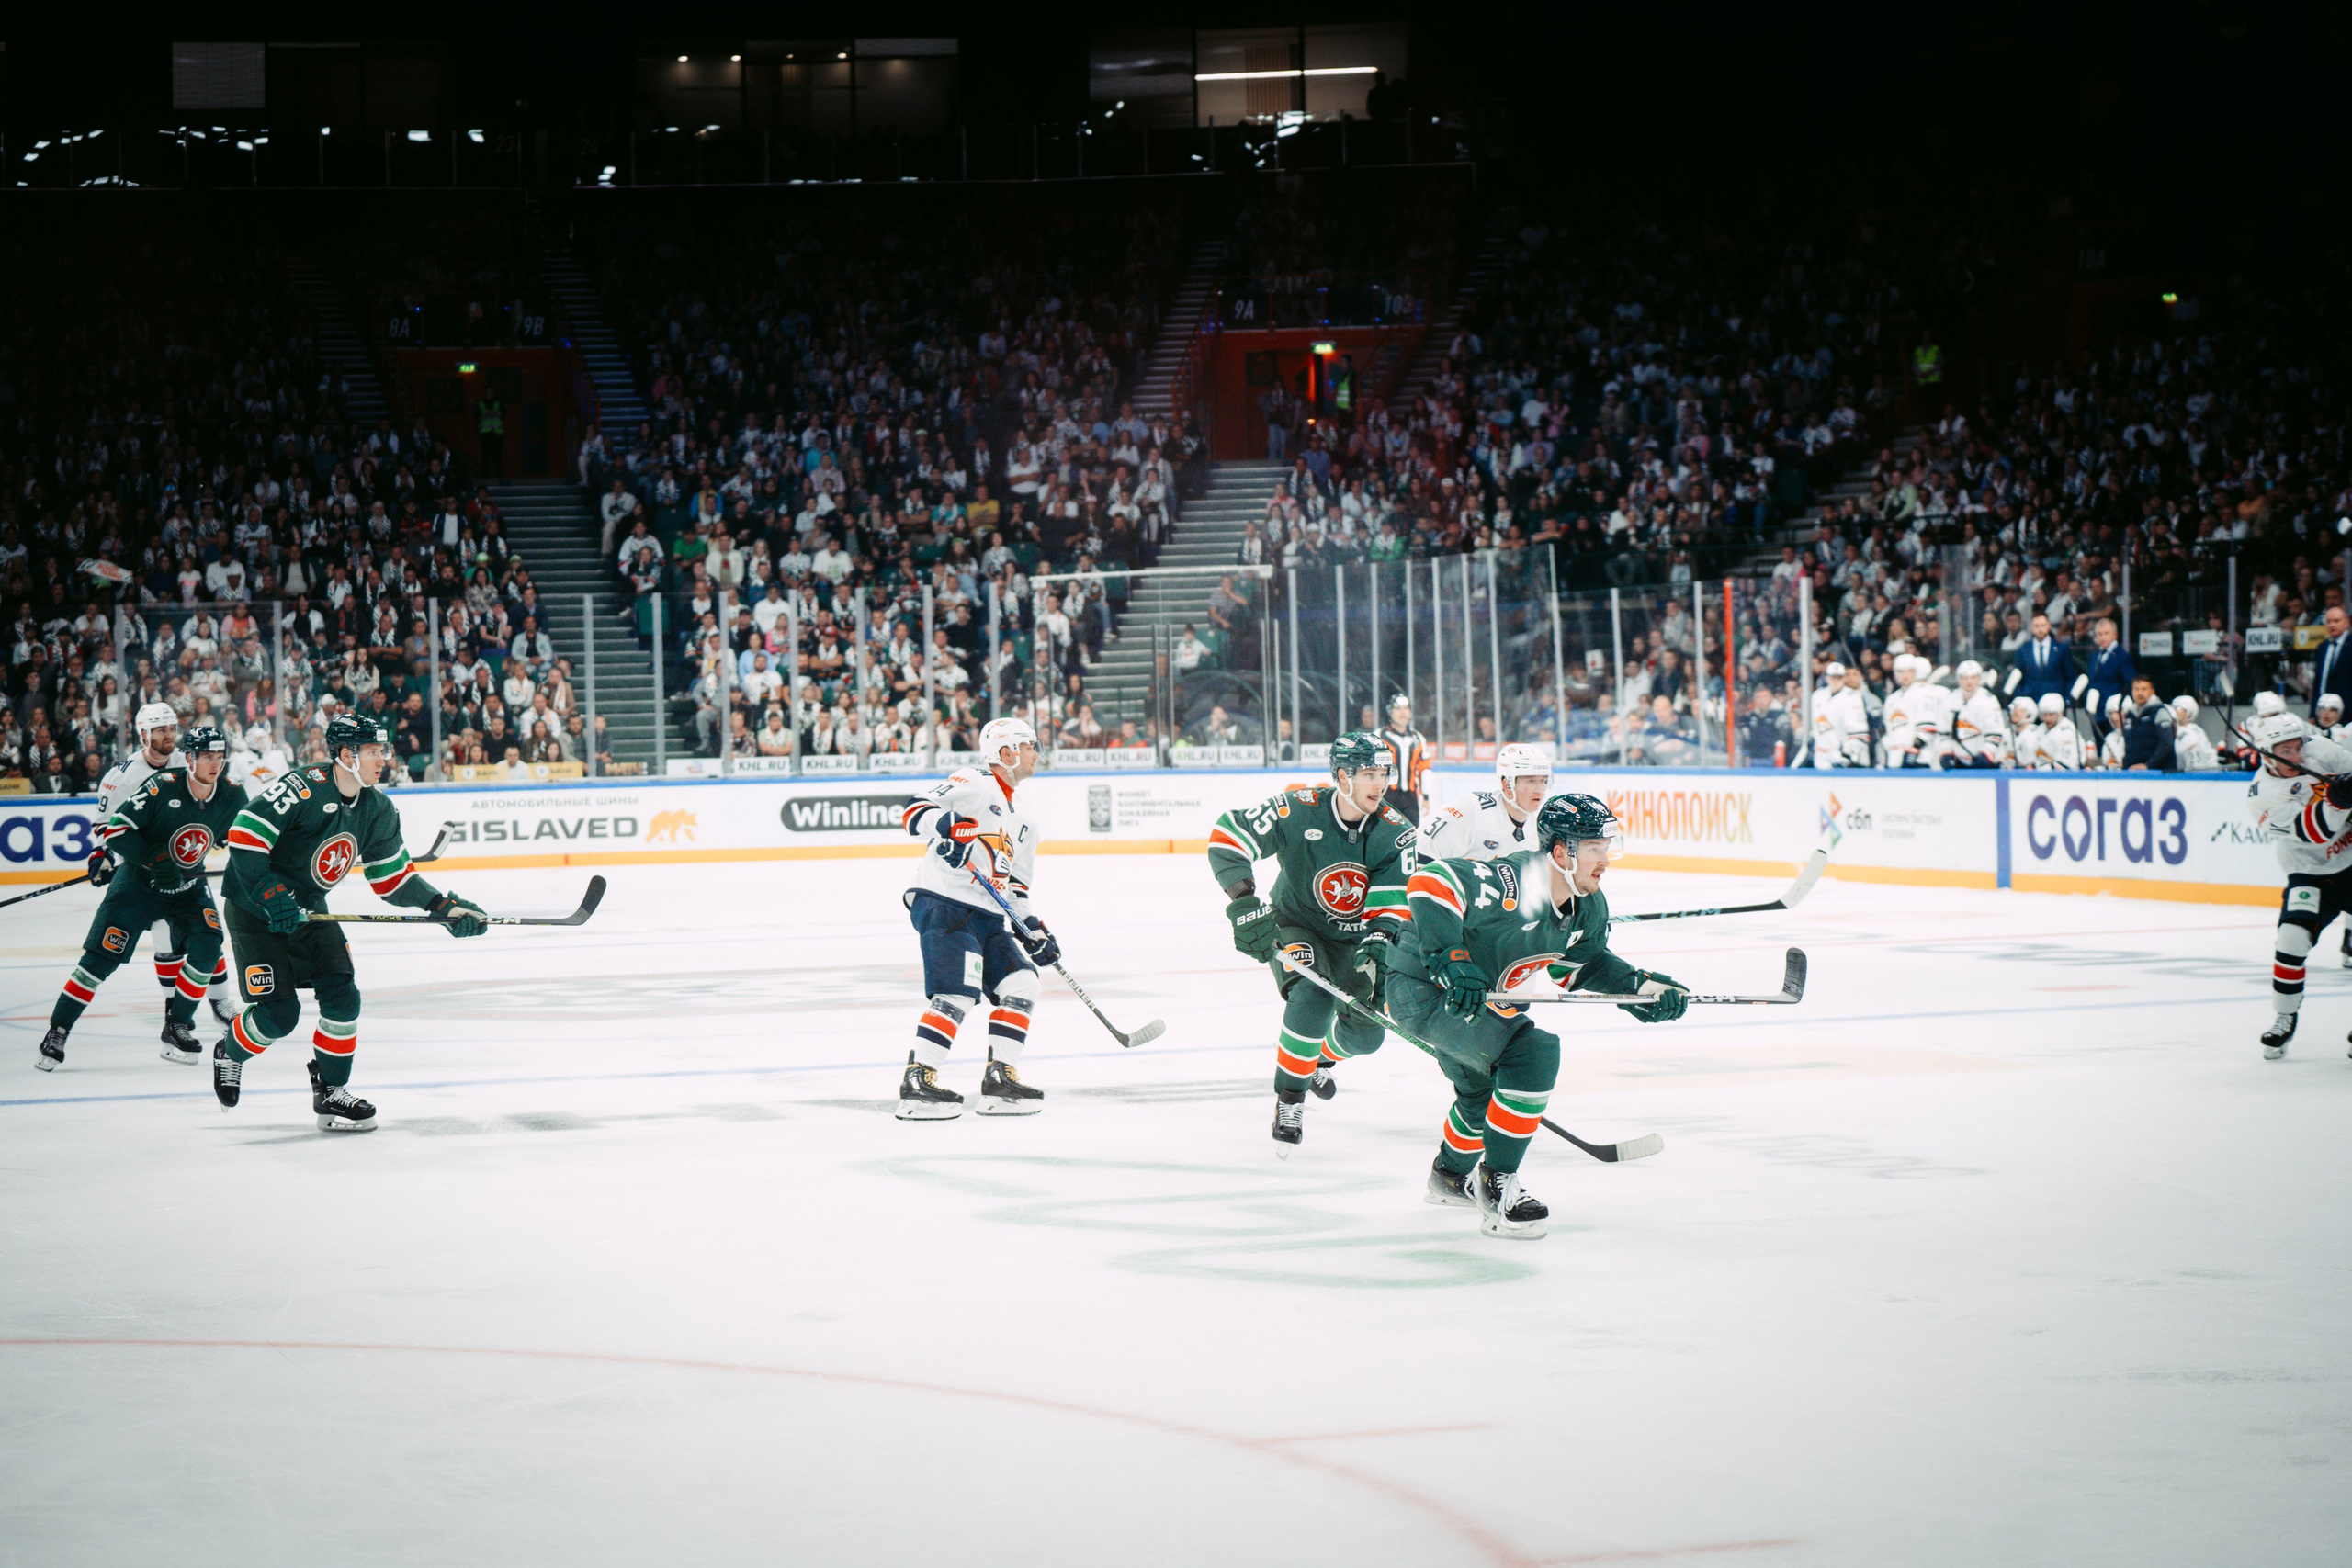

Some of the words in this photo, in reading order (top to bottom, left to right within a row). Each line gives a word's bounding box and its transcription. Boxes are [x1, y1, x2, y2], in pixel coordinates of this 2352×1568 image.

[1235, 299, 1255, 320] 9A
[389, 318, 410, 337] 8A
[523, 317, 545, 336] 9B
[2247, 633, 2278, 645] KHL.RU
[875, 756, 922, 767] KHL.RU
[1057, 752, 1102, 763] KHL.RU
[1110, 751, 1152, 762] KHL.RU
[1176, 750, 1215, 761] KHL.RU
[1224, 750, 1261, 760] KHL.RU
[1305, 748, 1329, 760] KHL.R
[739, 759, 786, 770] KHL.RU
[805, 757, 854, 770] KHL.RU
[262, 782, 300, 815] 93
[471, 795, 591, 809] АВТОМОБИЛЬНЫЕ
[596, 795, 639, 807] ШИНЫ
[790, 800, 903, 827] Winline
[1244, 798, 1278, 835] 65
[1846, 808, 1872, 829] сбп
[449, 817, 639, 843] GISLAVED
[1018, 824, 1028, 843] C
[1423, 816, 1448, 839] 31
[2028, 795, 2188, 865] согаз
[1401, 845, 1419, 875] 6
[1472, 861, 1501, 909] 44
[1499, 864, 1515, 897] Winline
[21, 882, 65, 900] CCM
[1659, 908, 1722, 919] CCM
[107, 933, 125, 947] Win
[1289, 949, 1312, 962] Win
[251, 975, 273, 986] Win
[1370, 1013, 1435, 1055] JETSPEED
